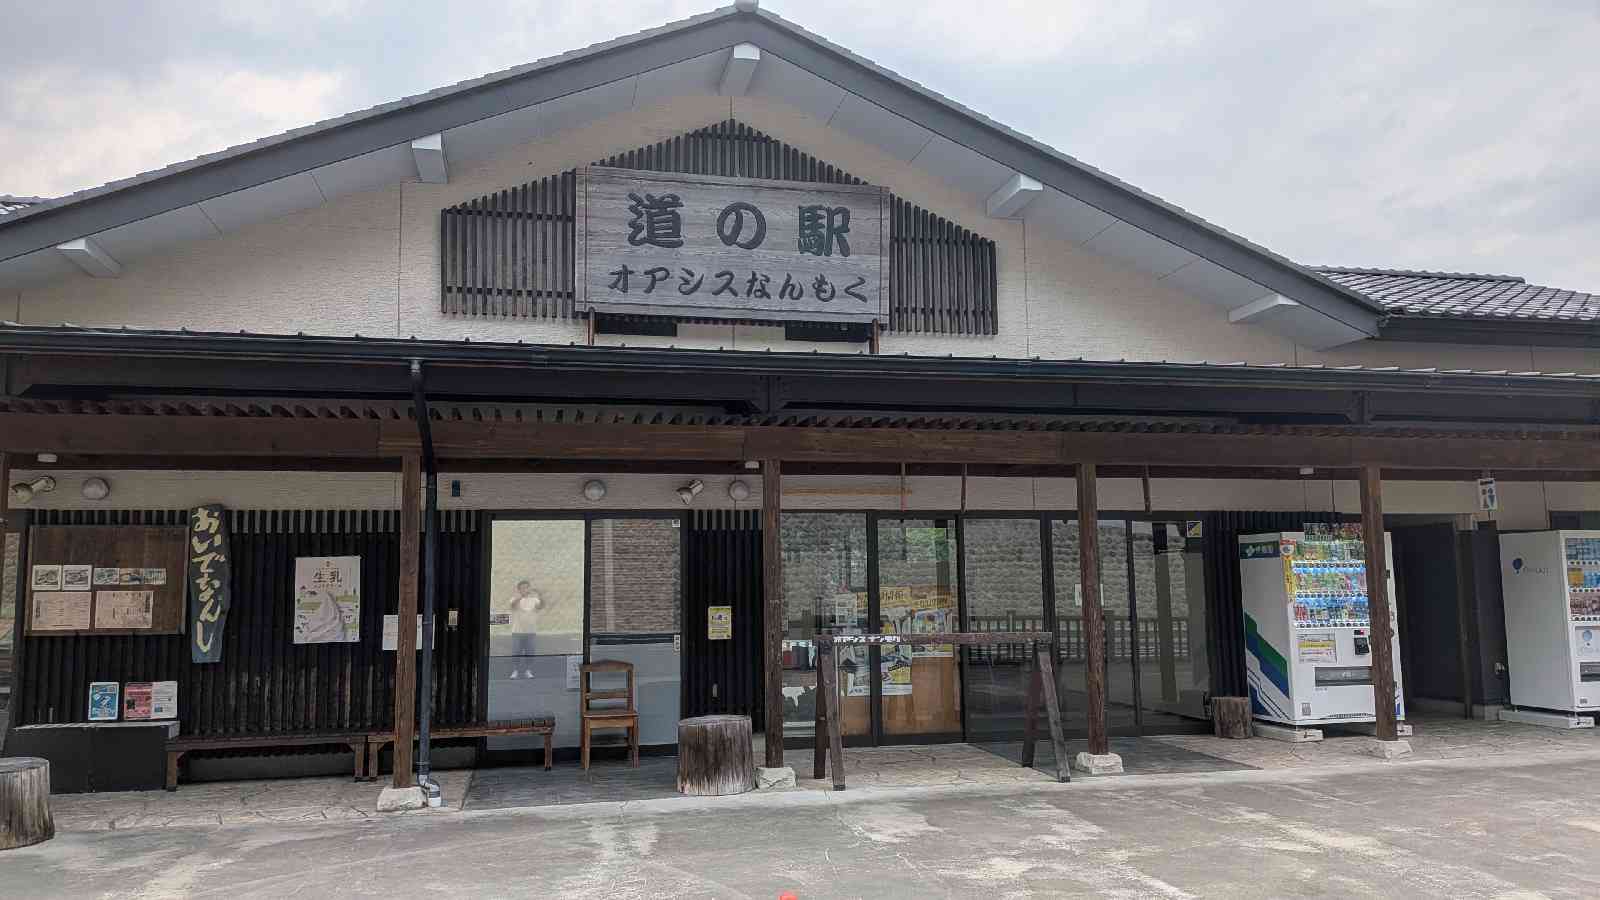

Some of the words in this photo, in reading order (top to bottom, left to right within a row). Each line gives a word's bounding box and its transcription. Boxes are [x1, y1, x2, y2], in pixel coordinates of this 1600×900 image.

[627, 193, 850, 257] 道の駅
[608, 264, 867, 302] オアシスなんもく
